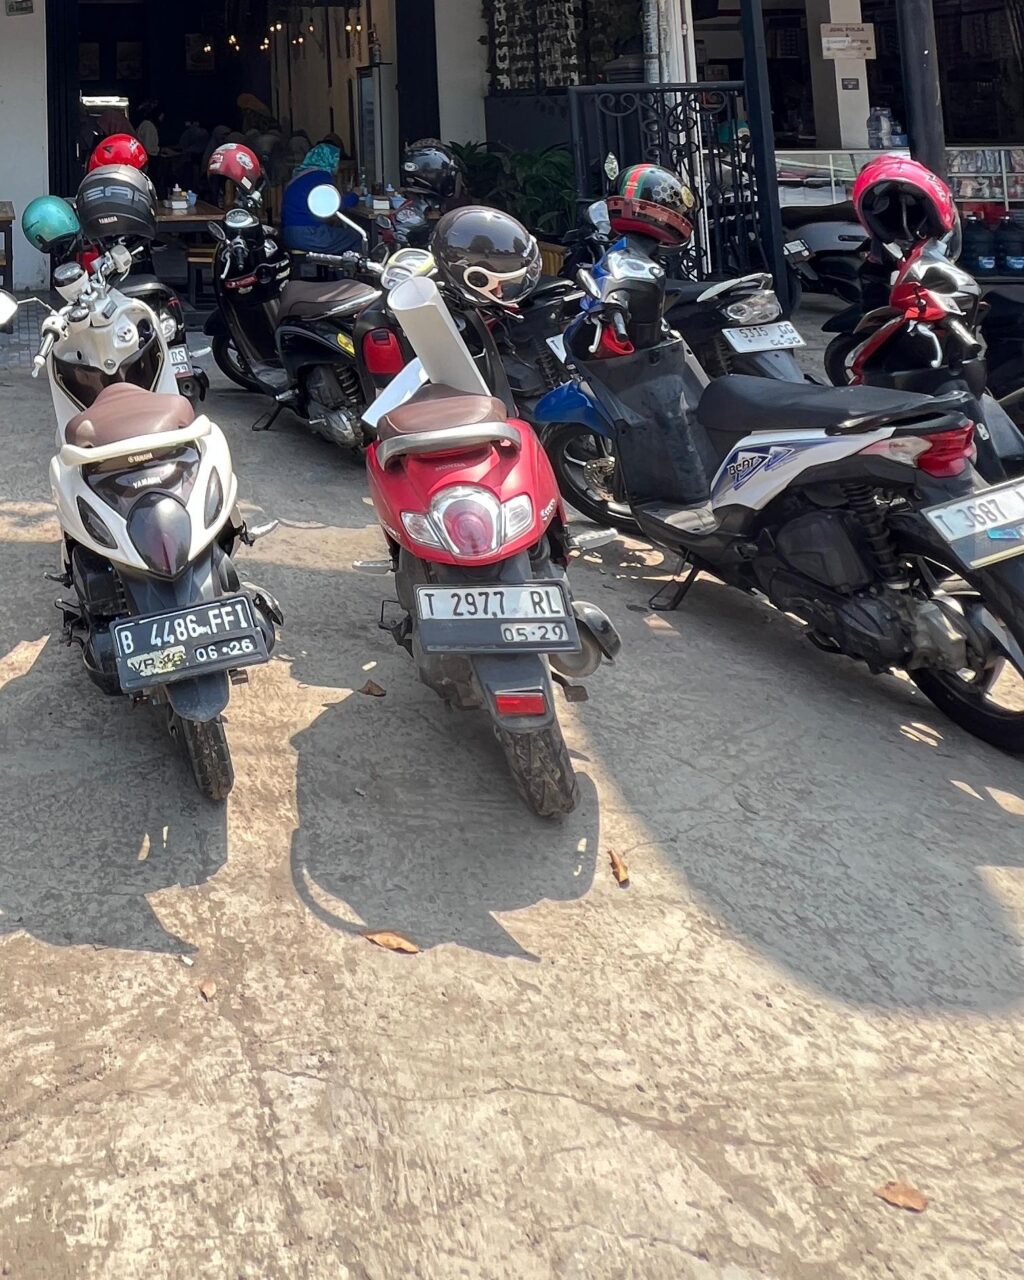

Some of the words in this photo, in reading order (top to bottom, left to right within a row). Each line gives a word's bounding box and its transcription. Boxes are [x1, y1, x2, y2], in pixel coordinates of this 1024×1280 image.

[134, 452, 154, 462] YAMAHA
[132, 476, 162, 489] YAMAHA
[933, 514, 955, 536] T
[424, 593, 435, 616] T
[450, 591, 505, 617] 2977
[529, 590, 562, 615] RL
[120, 630, 135, 655] B
[150, 614, 200, 648] 4486
